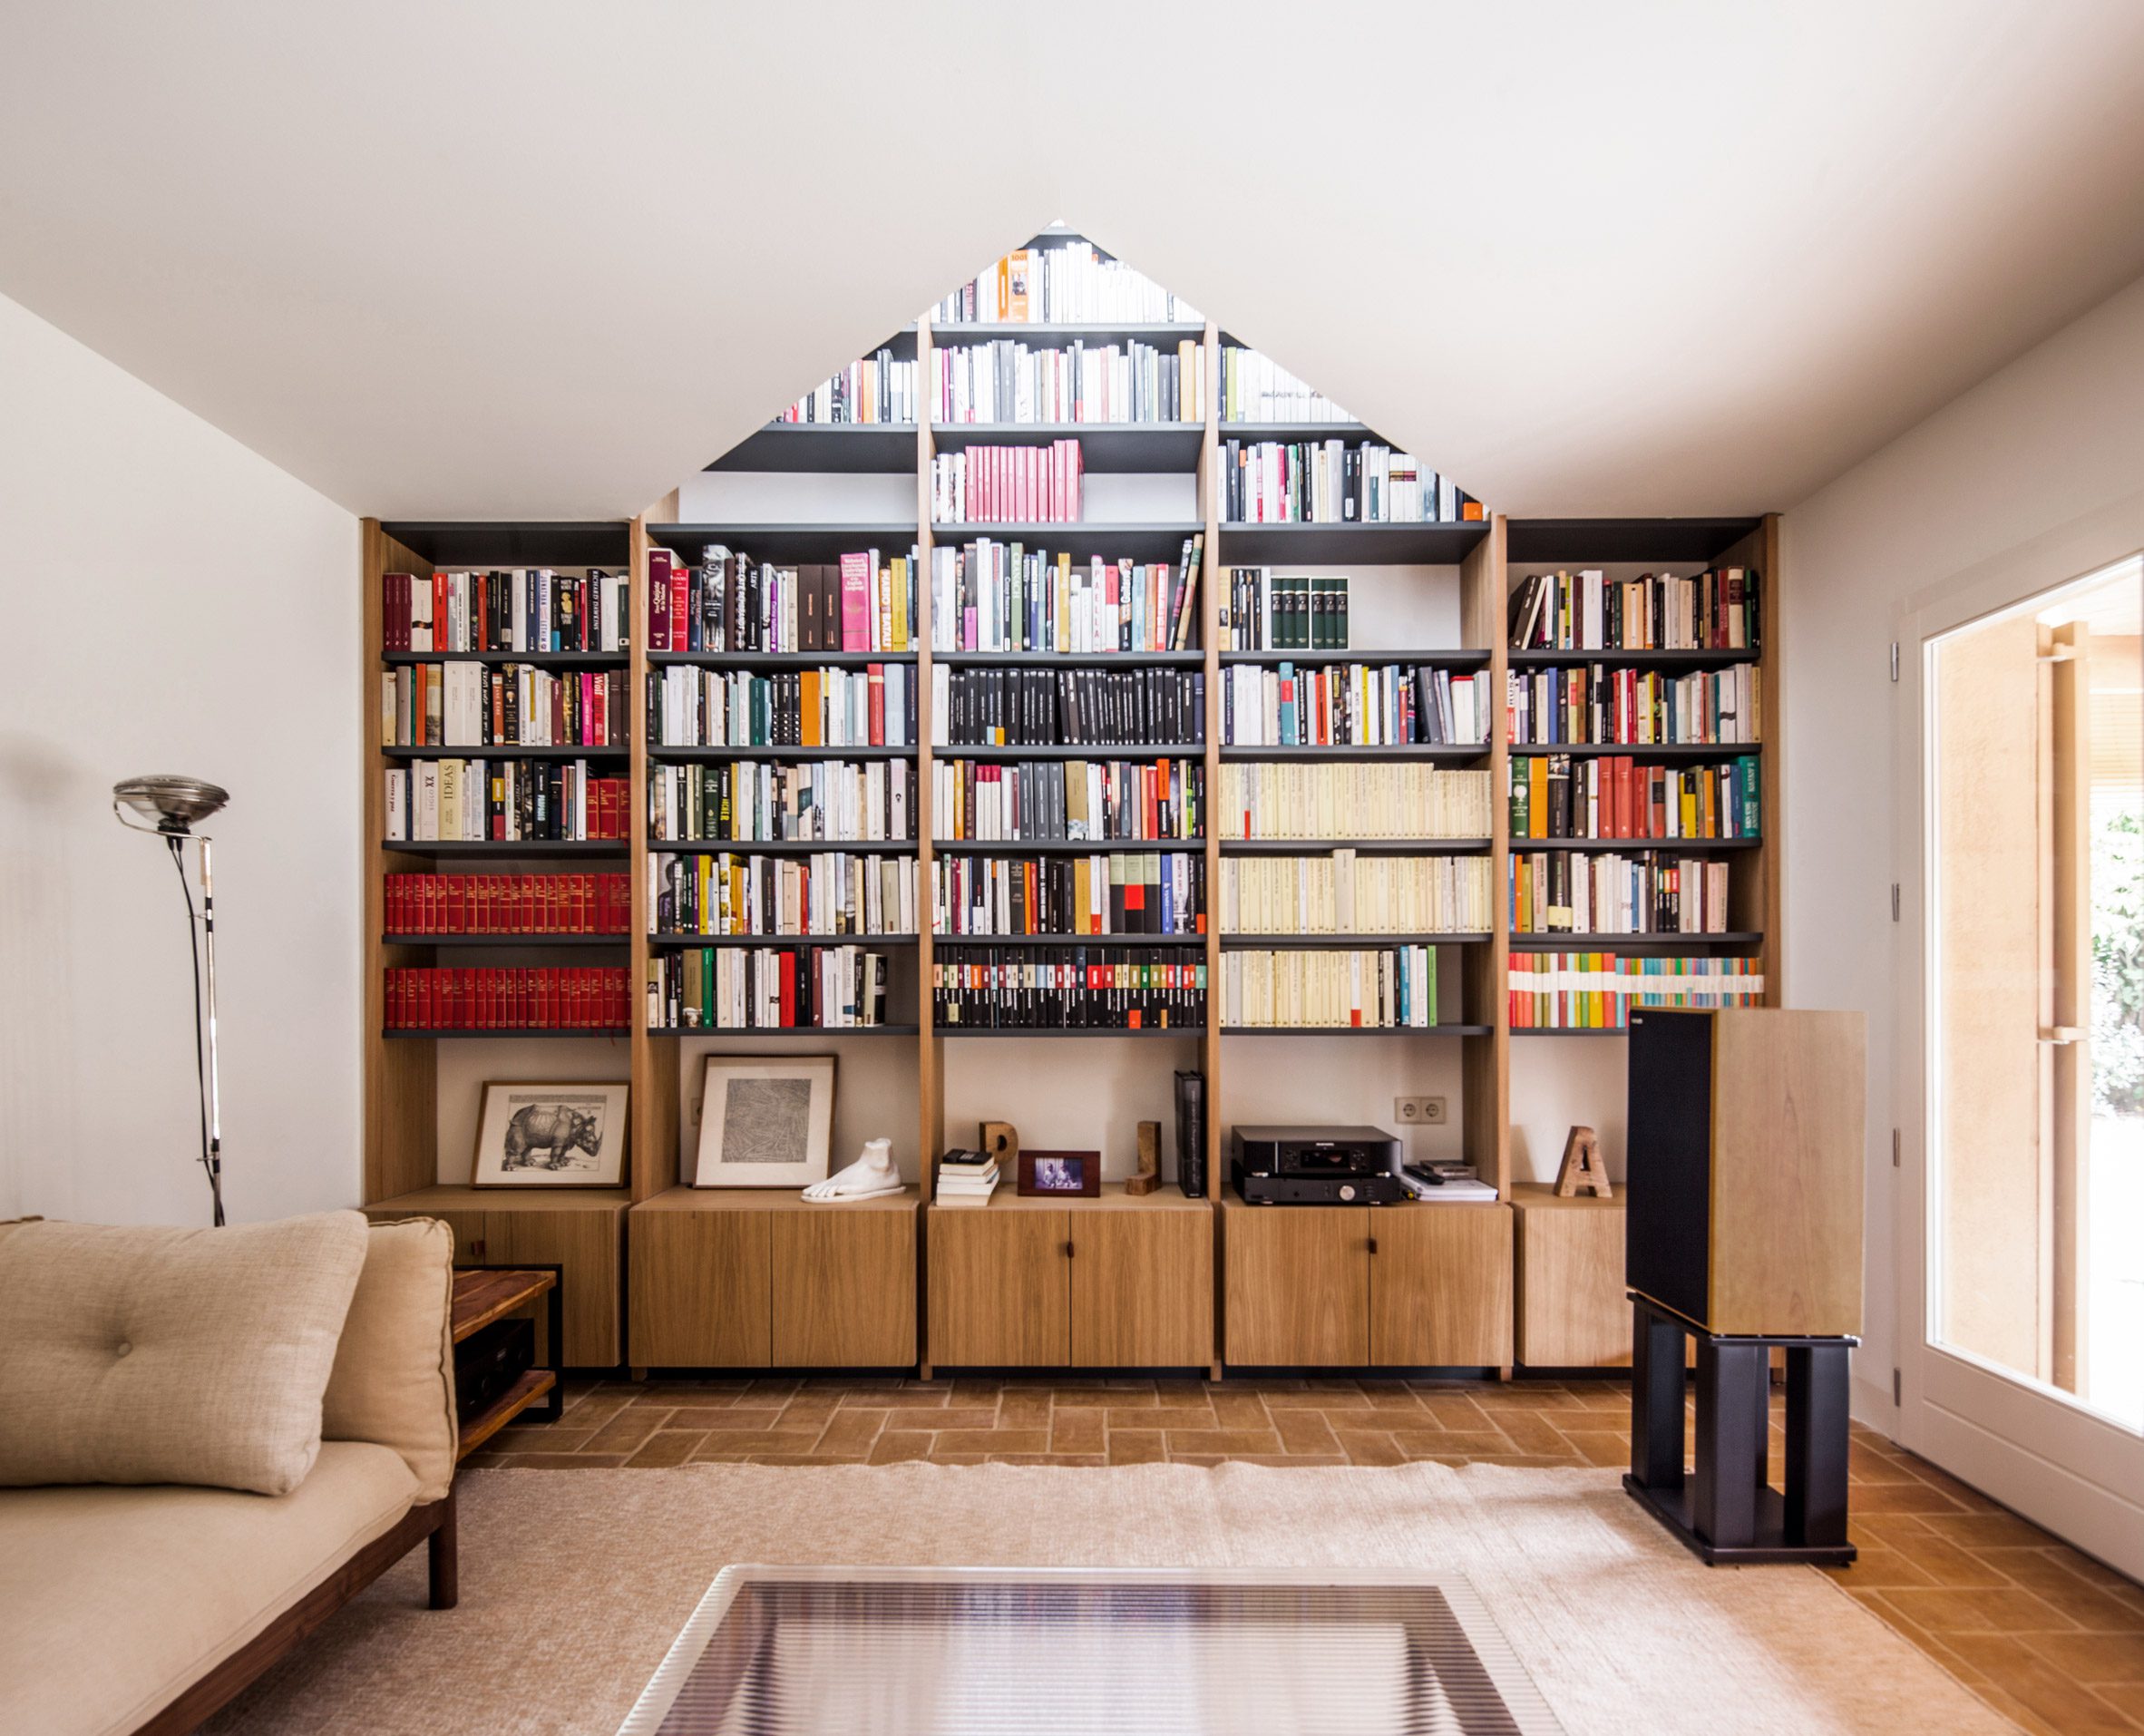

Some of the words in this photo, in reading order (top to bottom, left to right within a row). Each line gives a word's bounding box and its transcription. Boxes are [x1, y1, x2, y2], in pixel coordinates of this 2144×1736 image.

[652, 581, 661, 605] Quijote
[882, 571, 892, 605] MARIO
[882, 612, 892, 647] BATALI
[594, 676, 603, 696] Wolf
[425, 775, 434, 787] XX
[443, 765, 453, 799] IDEAS
[1553, 1126, 1613, 1198] A
